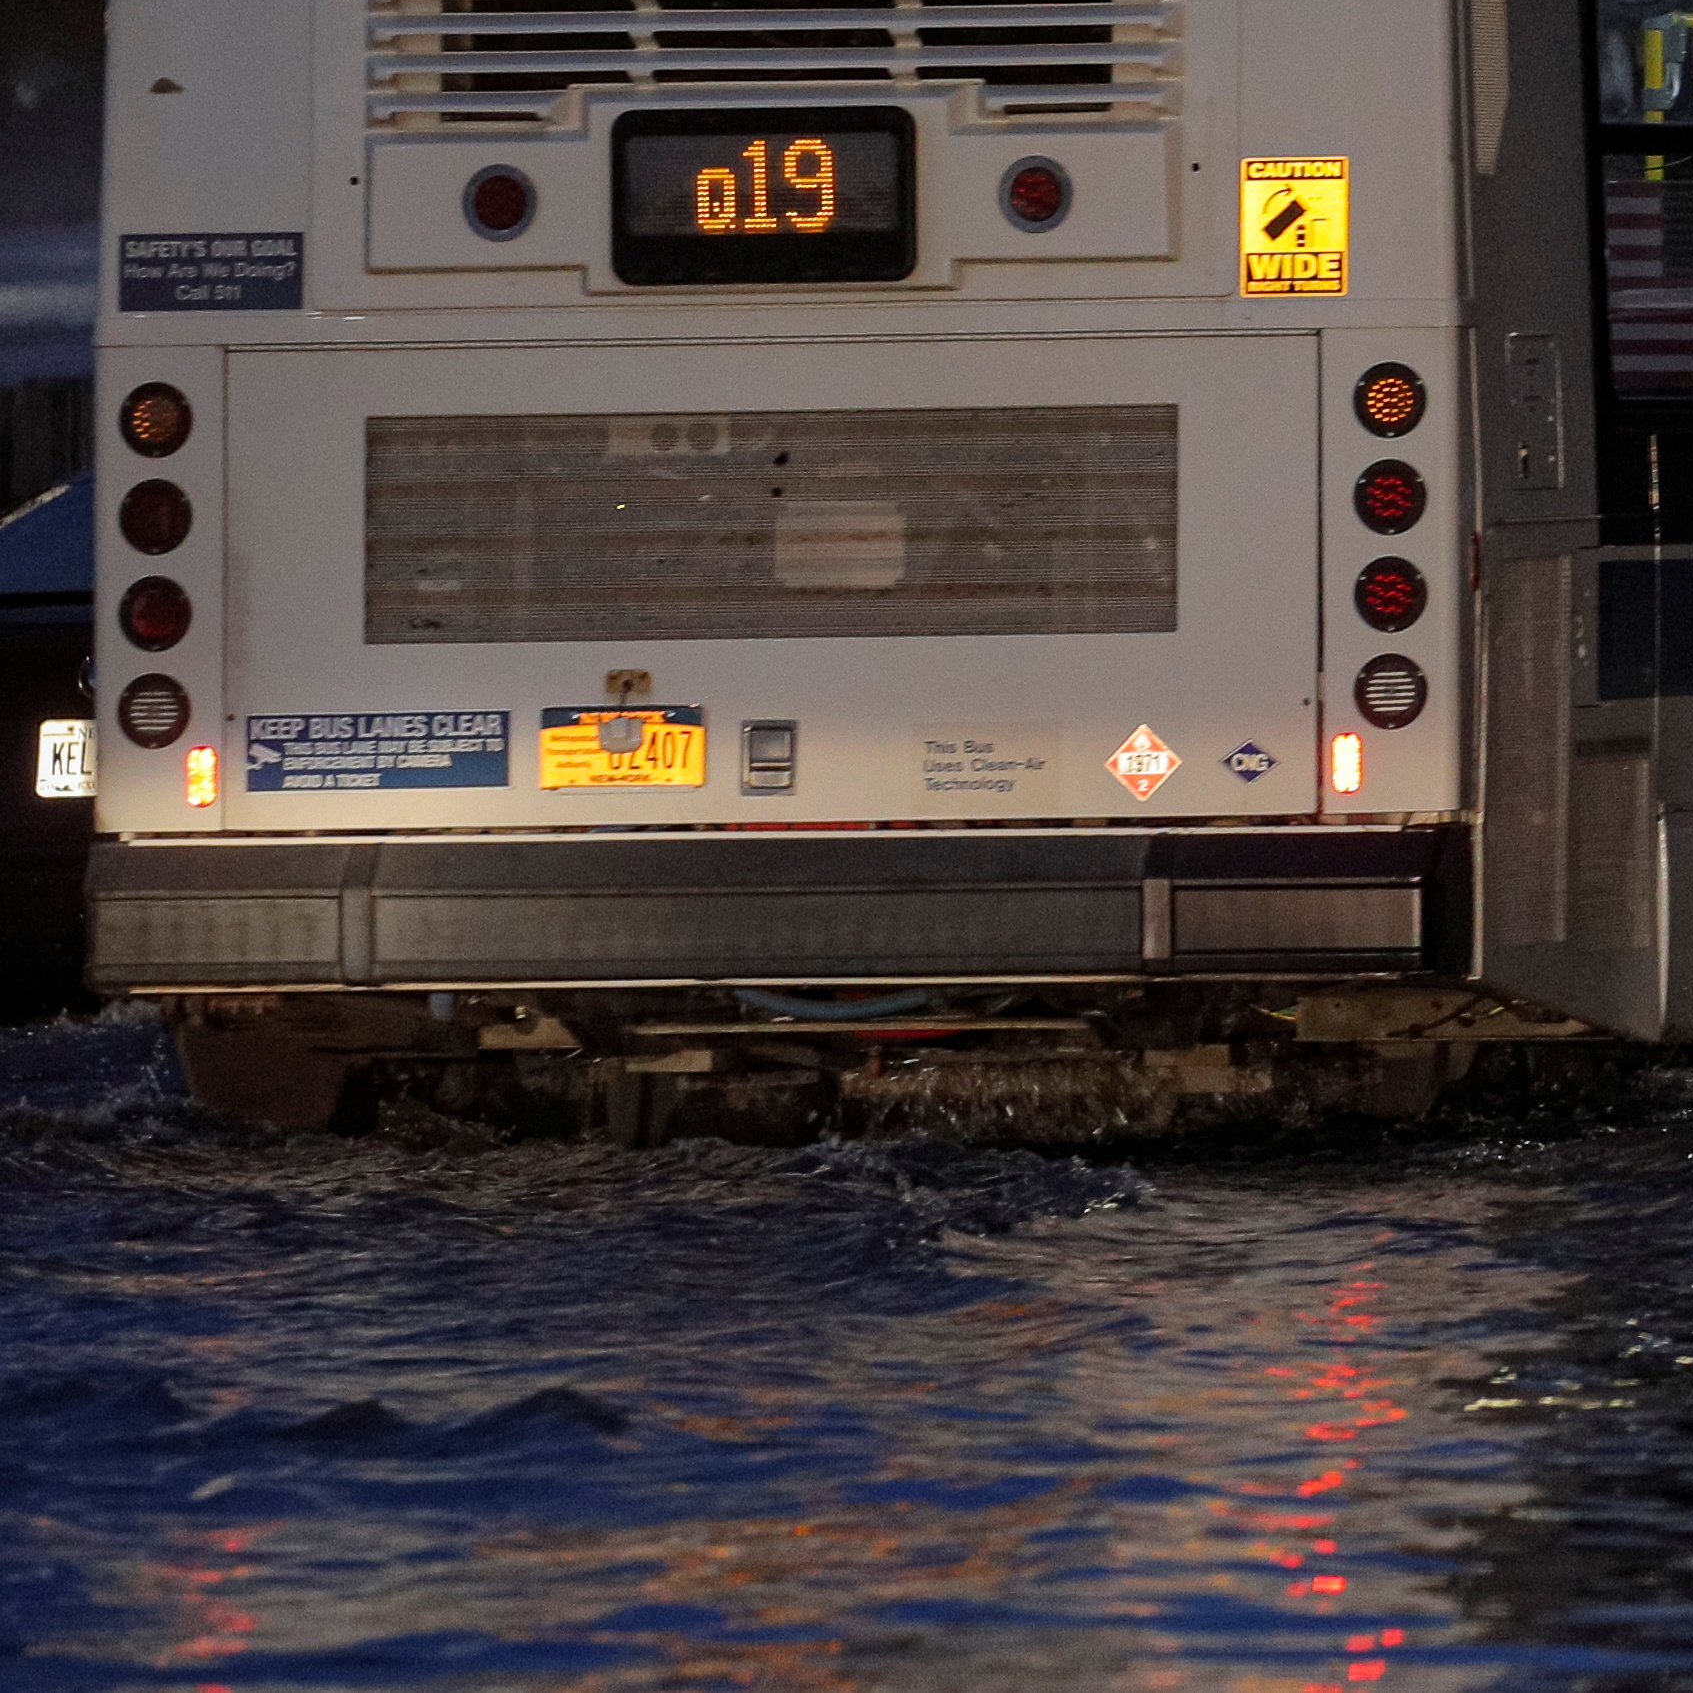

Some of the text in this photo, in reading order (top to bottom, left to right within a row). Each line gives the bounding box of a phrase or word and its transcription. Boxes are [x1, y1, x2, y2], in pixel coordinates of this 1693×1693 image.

[1248, 161, 1341, 178] CAUTION
[125, 238, 297, 257] SAFETY'S OUR GOAL
[124, 260, 297, 280] How Are We Doing?
[1247, 253, 1341, 279] WIDE
[175, 284, 210, 301] Call
[250, 714, 502, 740] KEEP BUS LANES CLEAR
[343, 740, 377, 754] LANE
[924, 739, 994, 754] This Bus
[52, 741, 93, 777] KEL
[282, 755, 376, 771] ENFORCEMENT
[923, 758, 1046, 773] Uses Clean-Air
[1125, 753, 1161, 773] 1971
[1229, 753, 1269, 772] CNG
[924, 777, 1016, 793] Technology
[1136, 779, 1149, 791] 2
